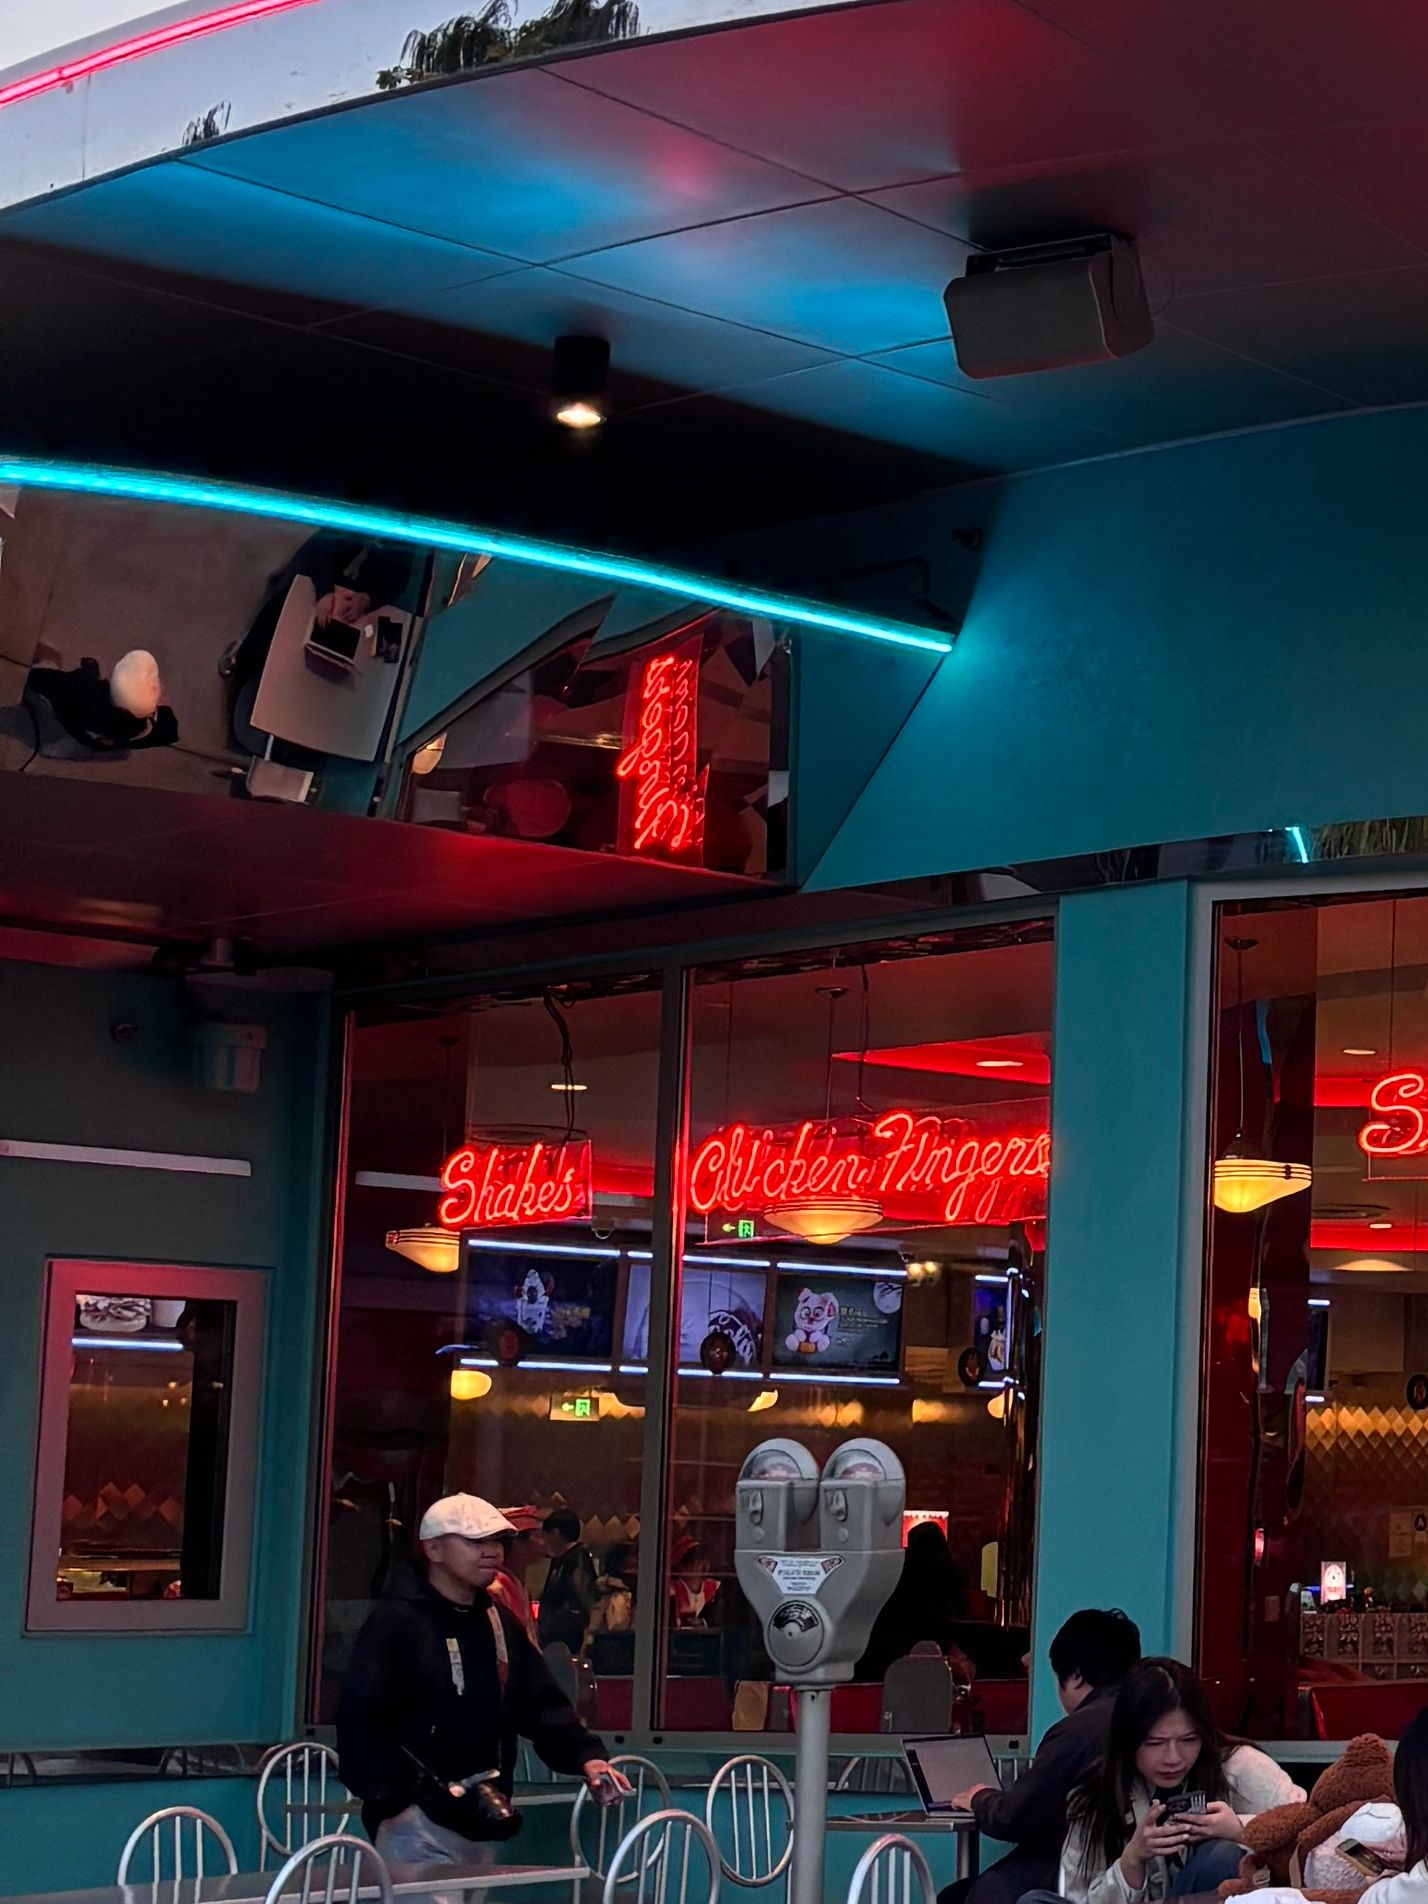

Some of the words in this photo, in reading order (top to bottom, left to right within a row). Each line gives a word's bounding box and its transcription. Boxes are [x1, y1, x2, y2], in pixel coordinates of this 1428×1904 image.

[439, 1142, 578, 1226] Shakes
[689, 1122, 866, 1212] Chicken
[873, 1112, 1051, 1222] Fingers
